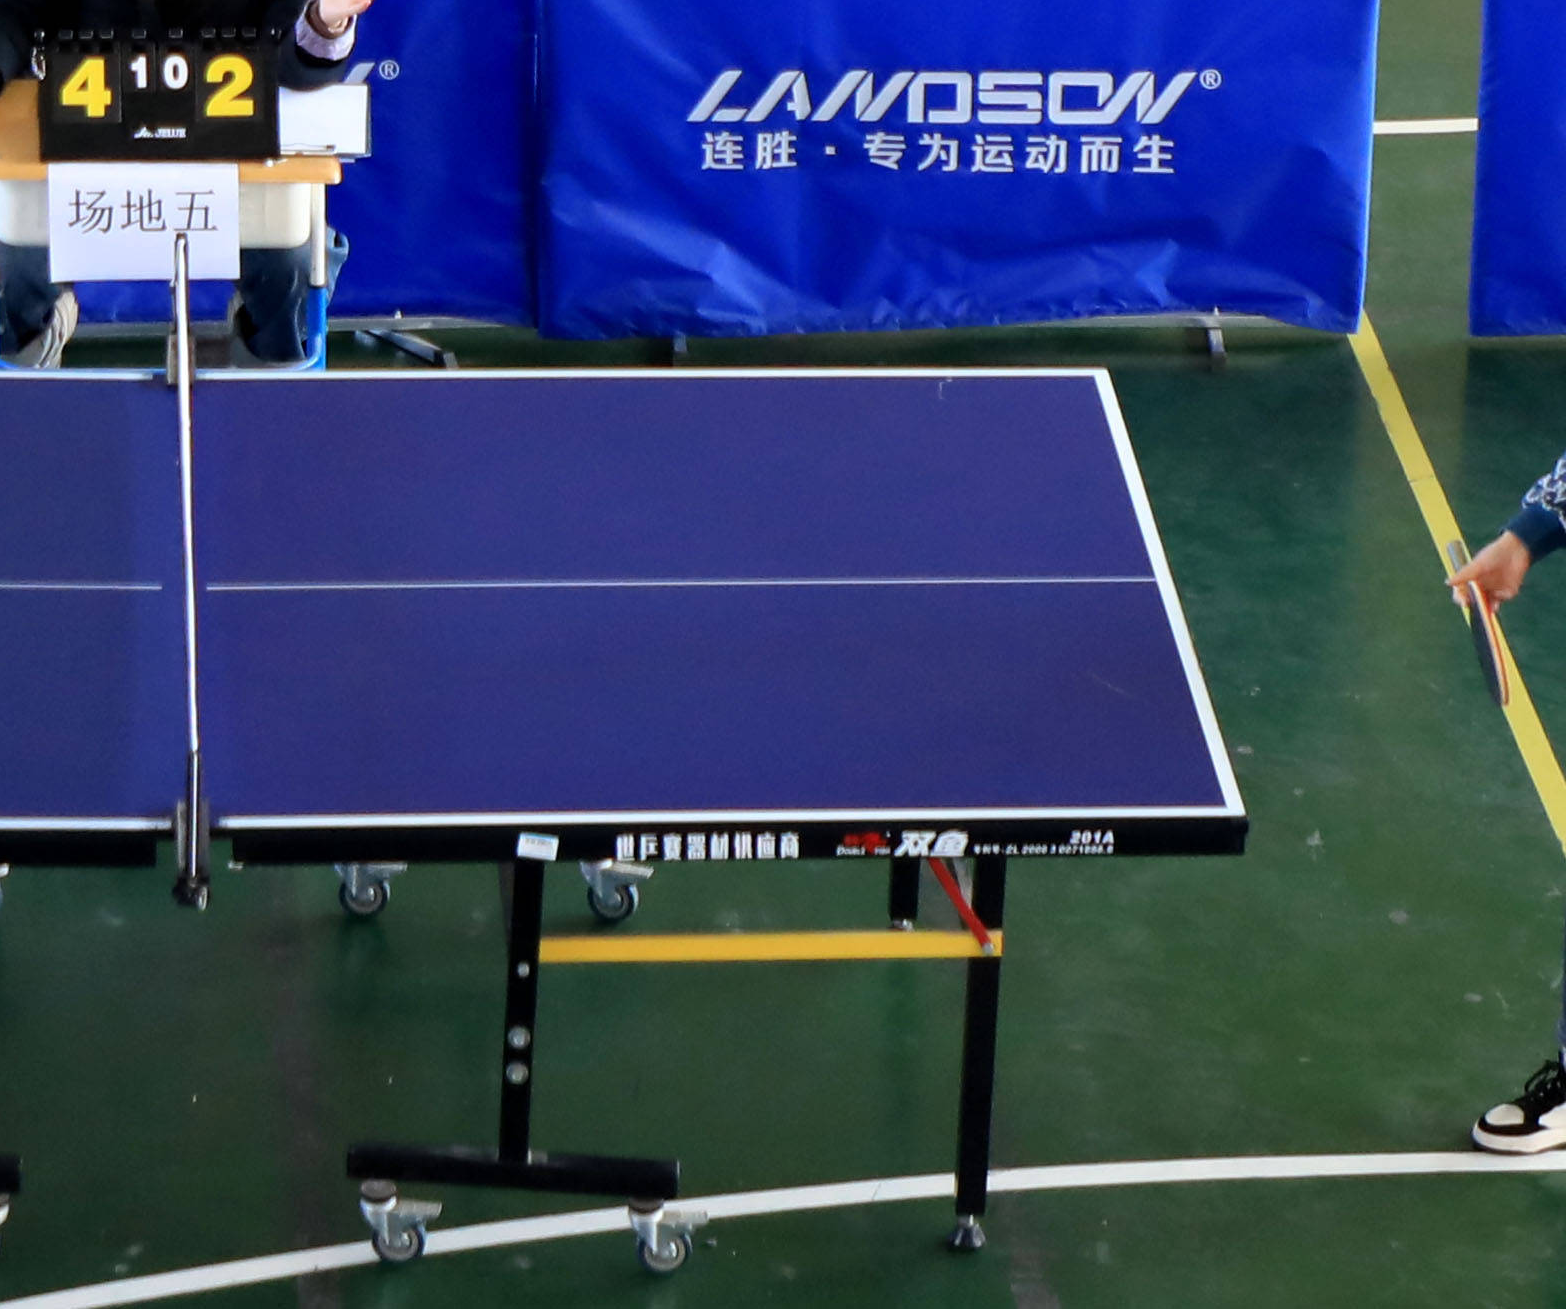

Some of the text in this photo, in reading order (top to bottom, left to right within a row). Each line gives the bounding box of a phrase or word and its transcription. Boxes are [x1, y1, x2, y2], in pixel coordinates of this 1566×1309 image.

[60, 57, 112, 118] 4
[205, 55, 255, 118] 2
[68, 188, 218, 234] 场地五
[893, 829, 969, 857] 双鱼
[1069, 829, 1115, 845] 201A
